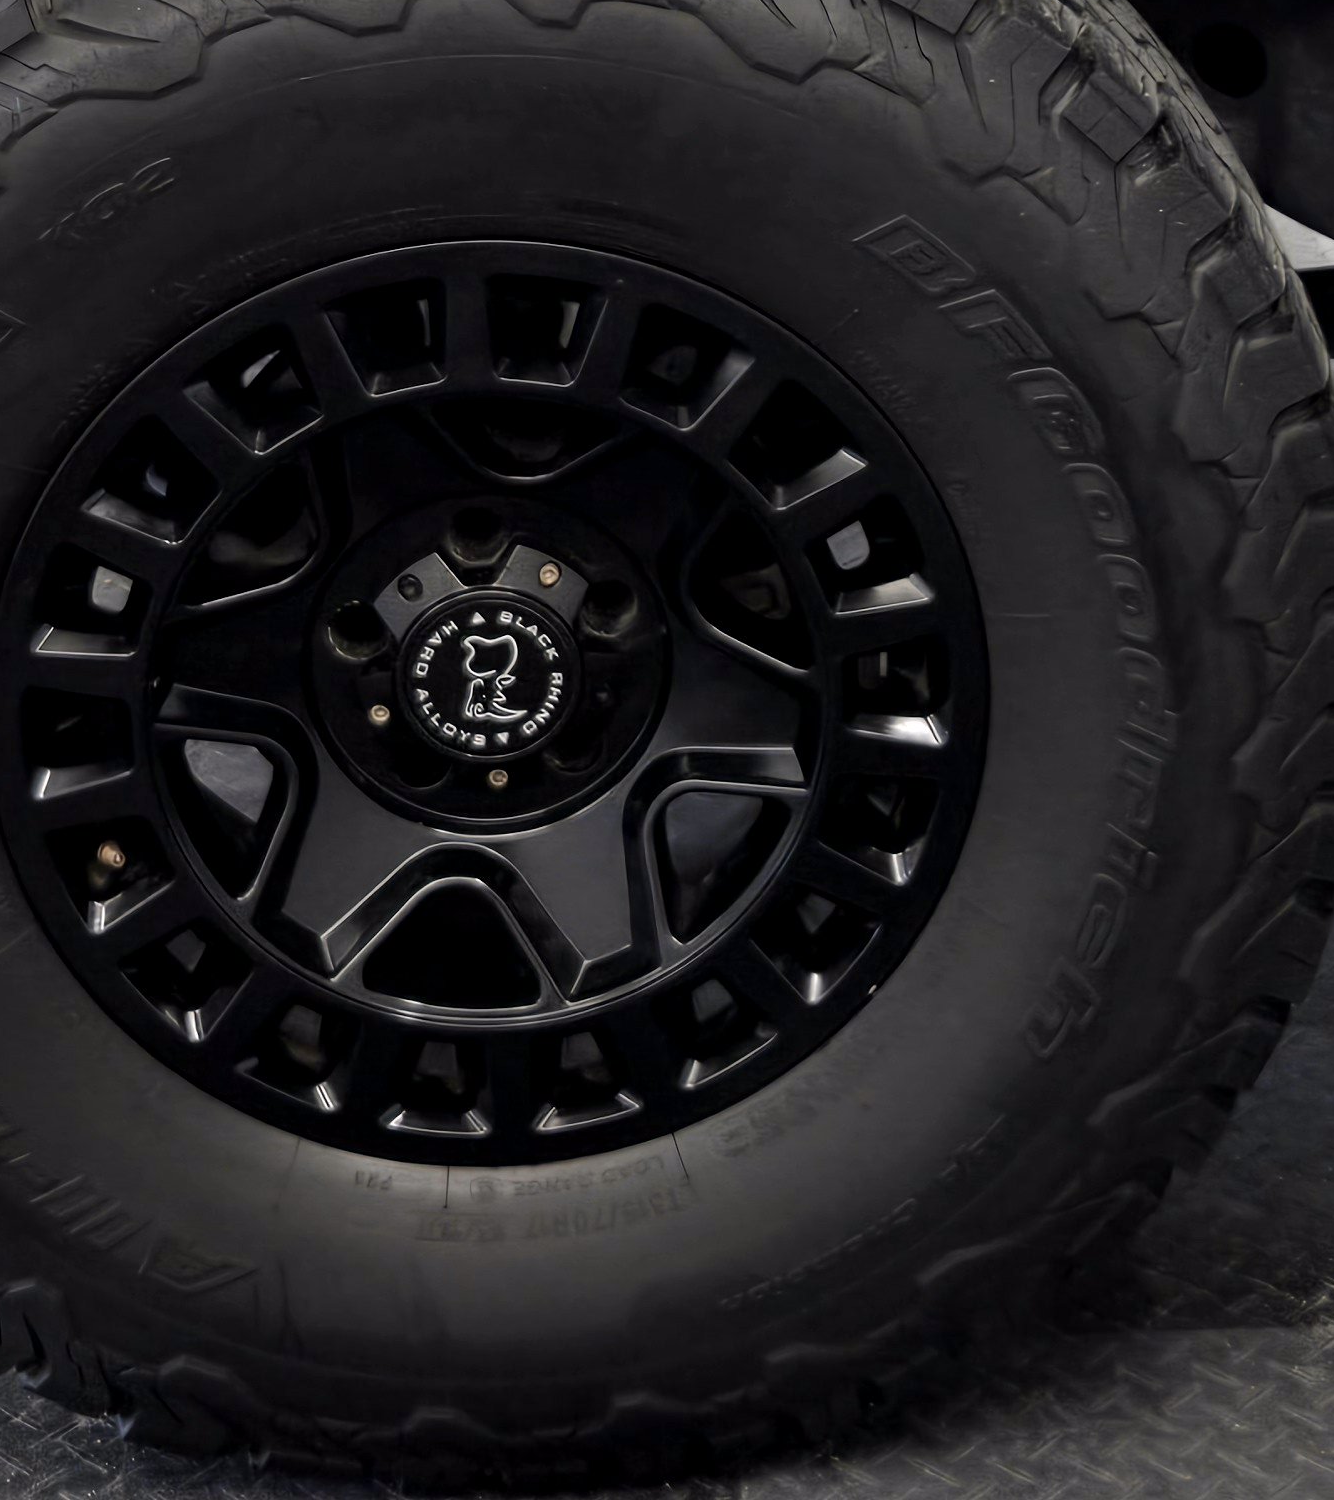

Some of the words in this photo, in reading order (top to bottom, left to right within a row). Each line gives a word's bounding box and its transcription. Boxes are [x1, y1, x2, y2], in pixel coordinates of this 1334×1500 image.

[416, 620, 459, 679] HARD
[499, 610, 560, 661] BLACK
[851, 213, 1177, 1062] BFGoodrich
[416, 687, 487, 747] ALLOYS
[522, 671, 564, 736] RHINO
